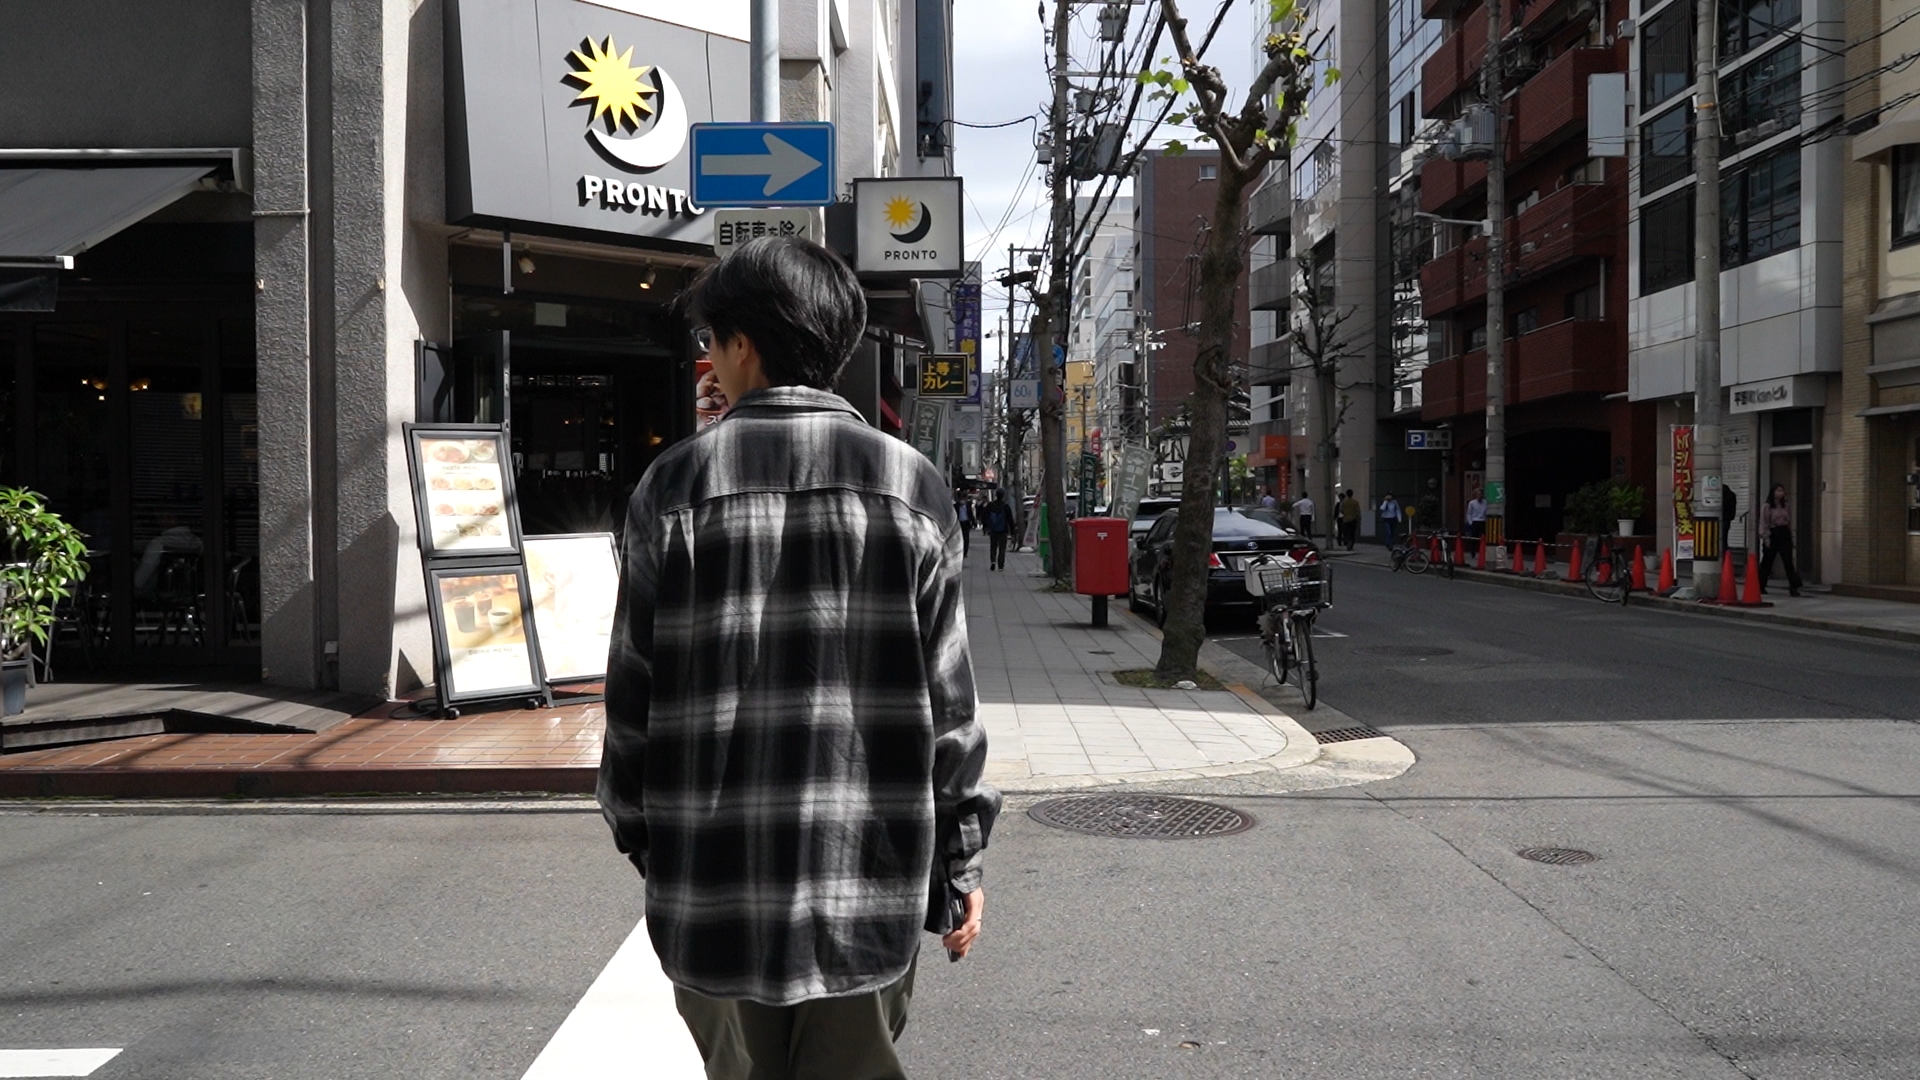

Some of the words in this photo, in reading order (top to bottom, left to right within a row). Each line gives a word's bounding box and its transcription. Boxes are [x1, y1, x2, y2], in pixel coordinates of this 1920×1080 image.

[884, 249, 938, 261] PRONTO
[922, 361, 951, 376] 上等
[923, 375, 964, 390] カレー
[1410, 434, 1422, 446] P
